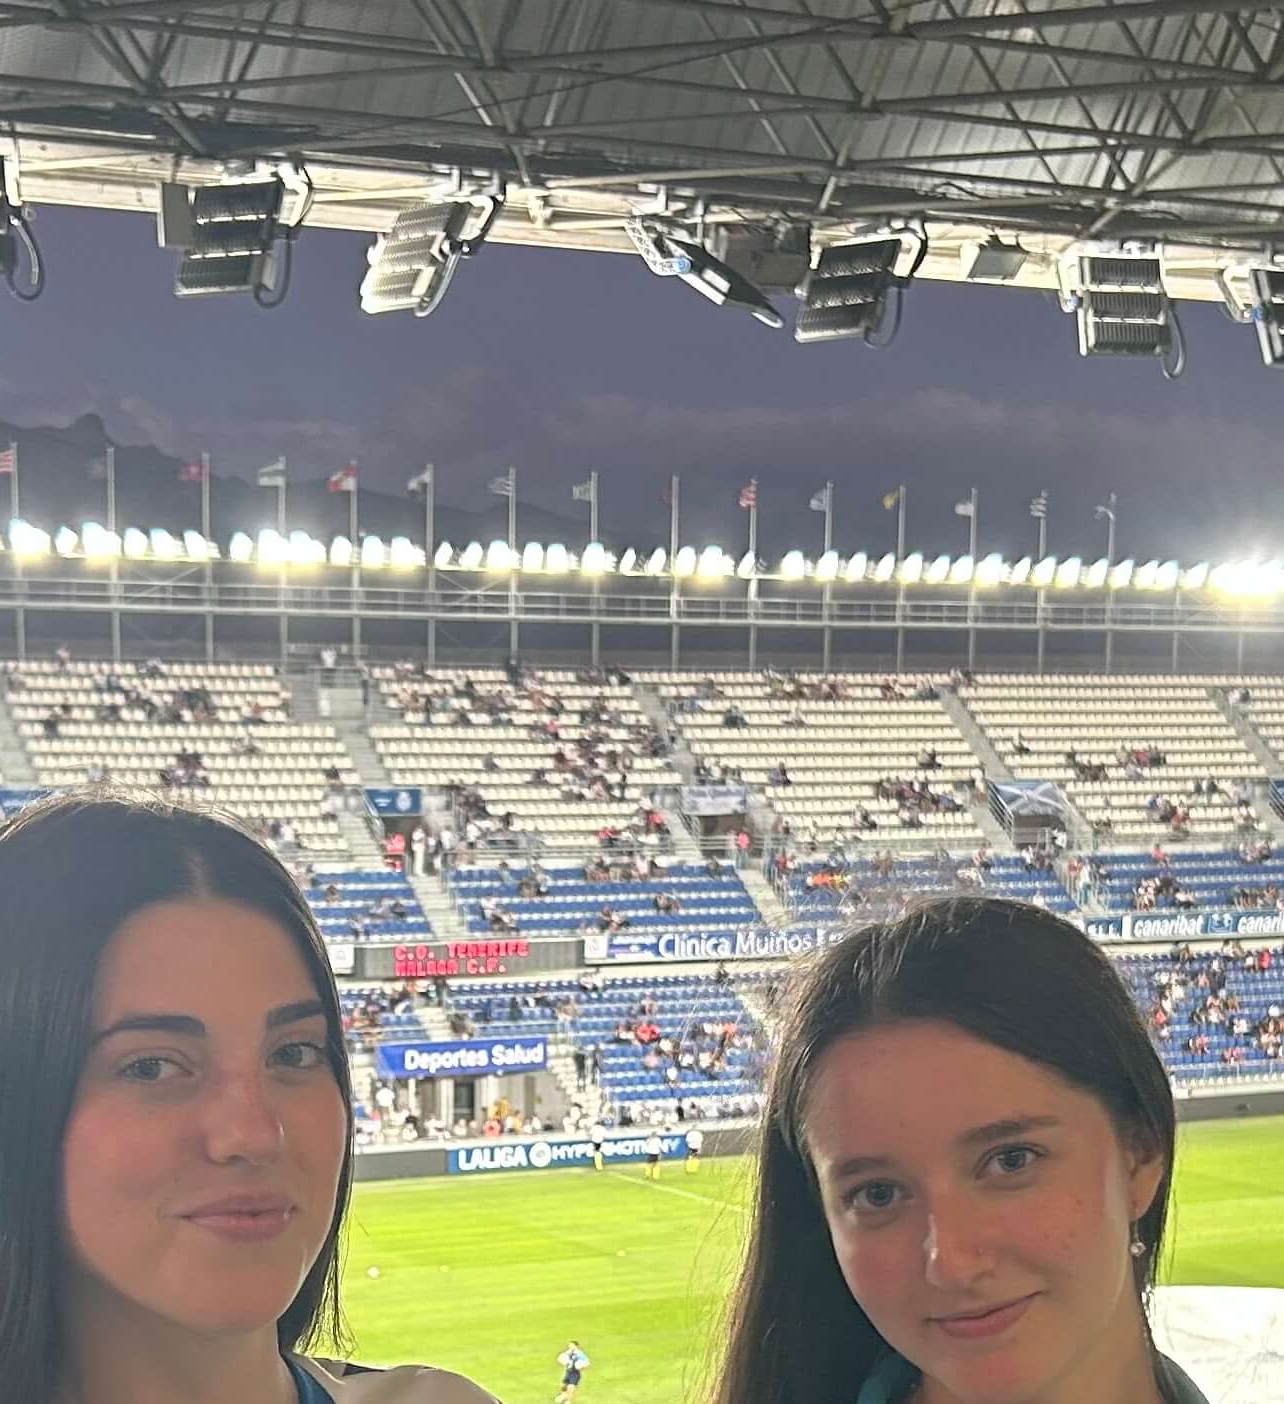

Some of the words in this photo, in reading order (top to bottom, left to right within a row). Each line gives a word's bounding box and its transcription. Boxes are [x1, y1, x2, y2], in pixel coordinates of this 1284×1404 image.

[447, 939, 529, 959] TENERIFE
[395, 960, 460, 977] MALAGA
[466, 958, 506, 975] C.F.
[404, 1048, 488, 1073] Deportes
[491, 1042, 545, 1066] Salud
[458, 1147, 528, 1171] LALIGA
